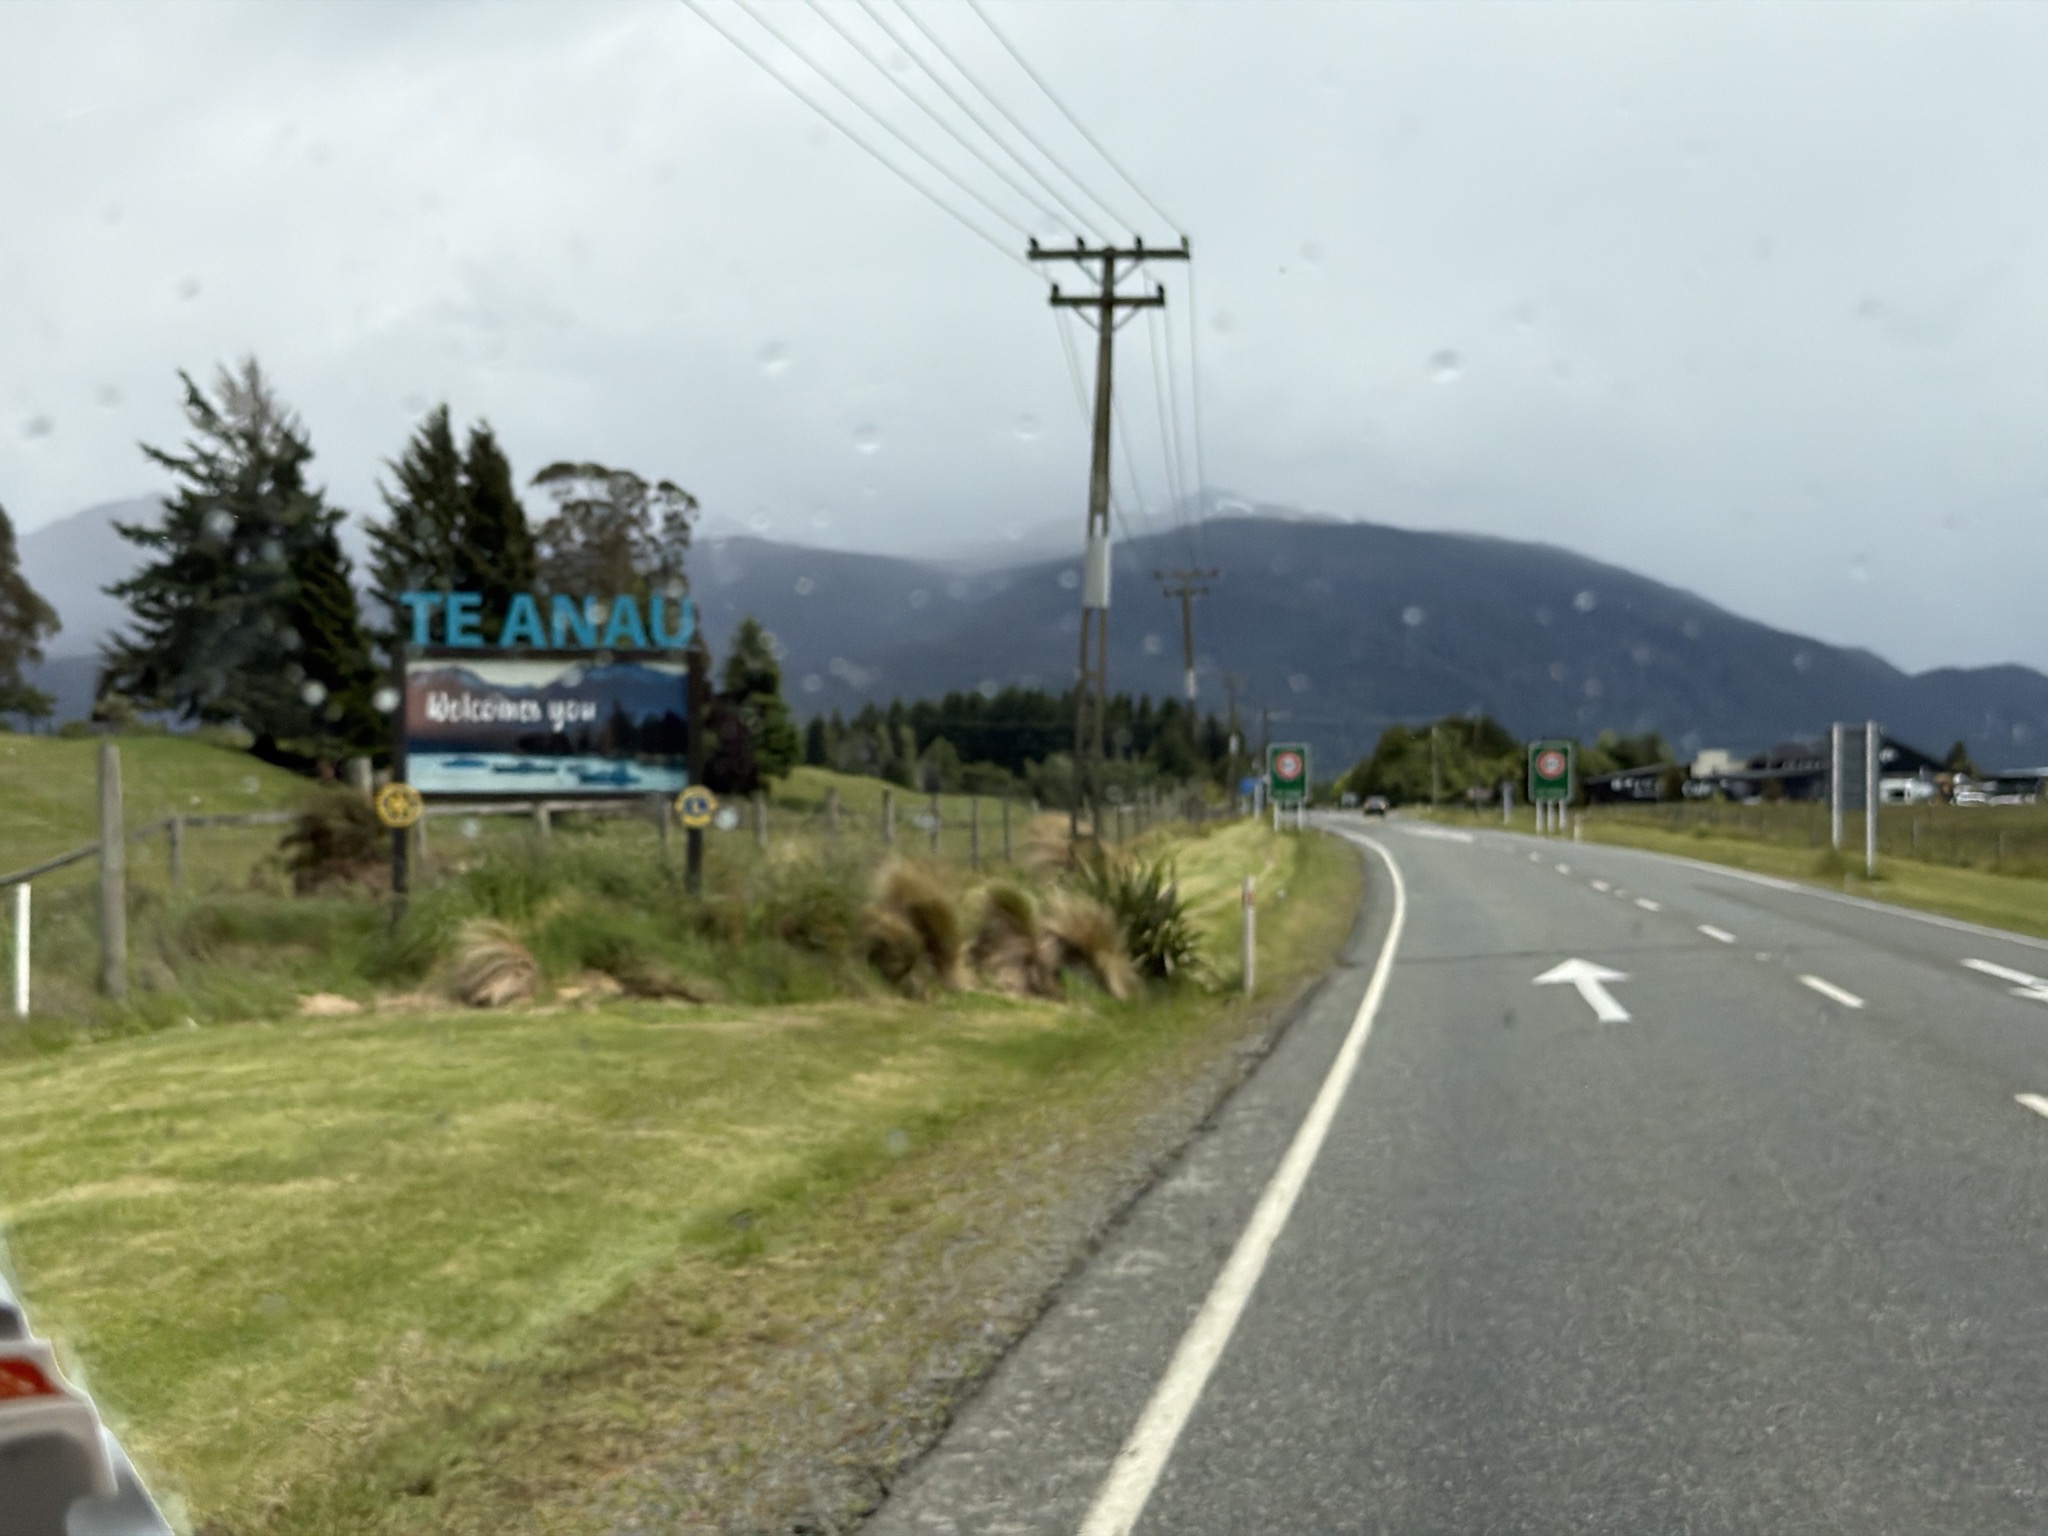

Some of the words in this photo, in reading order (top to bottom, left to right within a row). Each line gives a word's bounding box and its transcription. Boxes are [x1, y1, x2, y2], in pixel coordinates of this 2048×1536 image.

[401, 591, 483, 648] TE
[499, 593, 693, 648] ANAU
[547, 701, 597, 731] you
